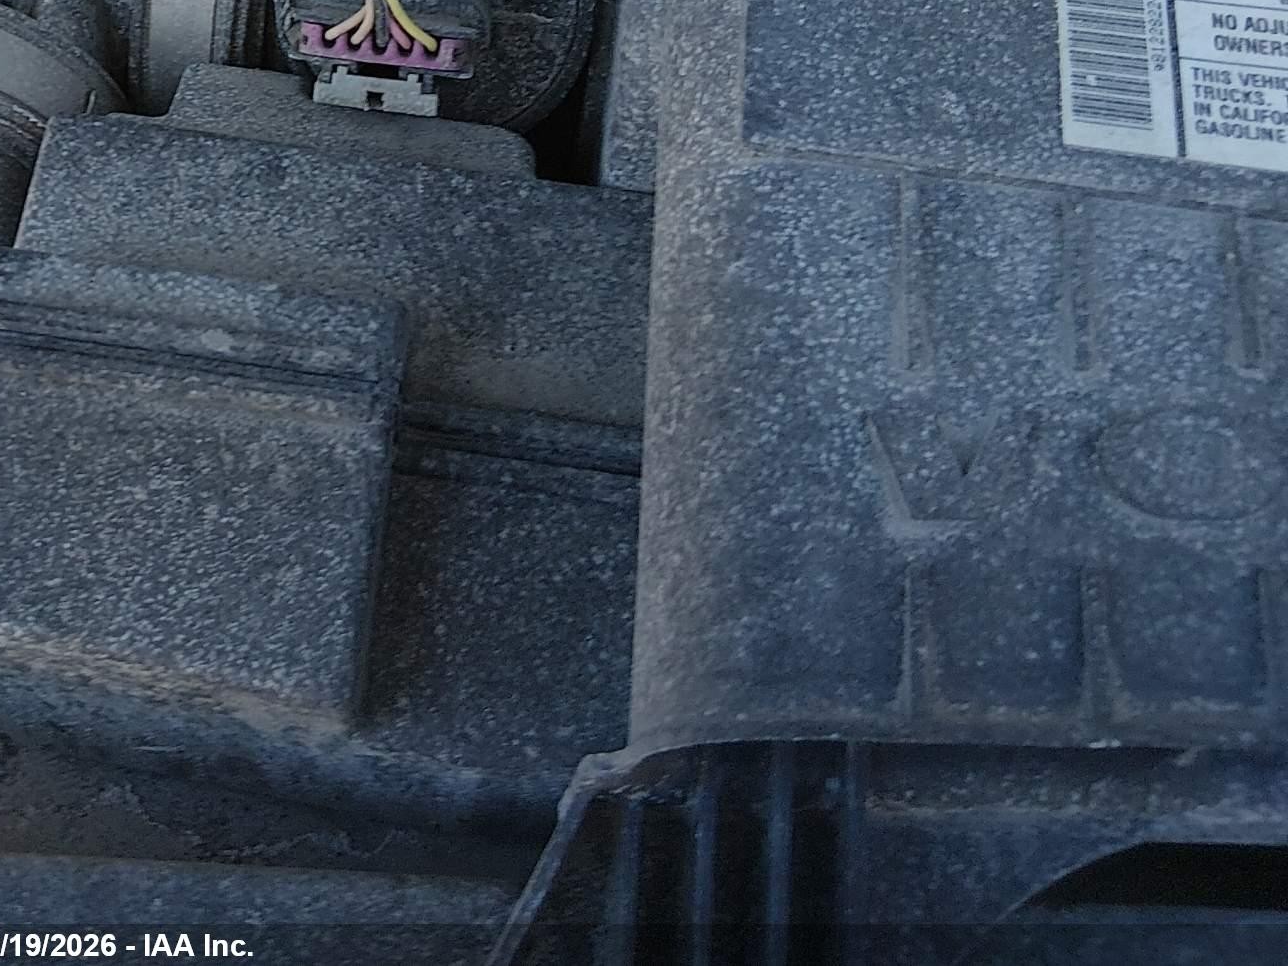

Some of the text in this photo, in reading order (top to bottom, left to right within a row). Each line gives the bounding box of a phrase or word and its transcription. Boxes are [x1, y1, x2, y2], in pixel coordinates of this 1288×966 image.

[1211, 12, 1237, 31] NO
[1191, 66, 1232, 85] THIS
[1192, 83, 1272, 107] TRUCKS.
[1193, 100, 1212, 118] IN
[1195, 118, 1287, 144] GASOLINE
